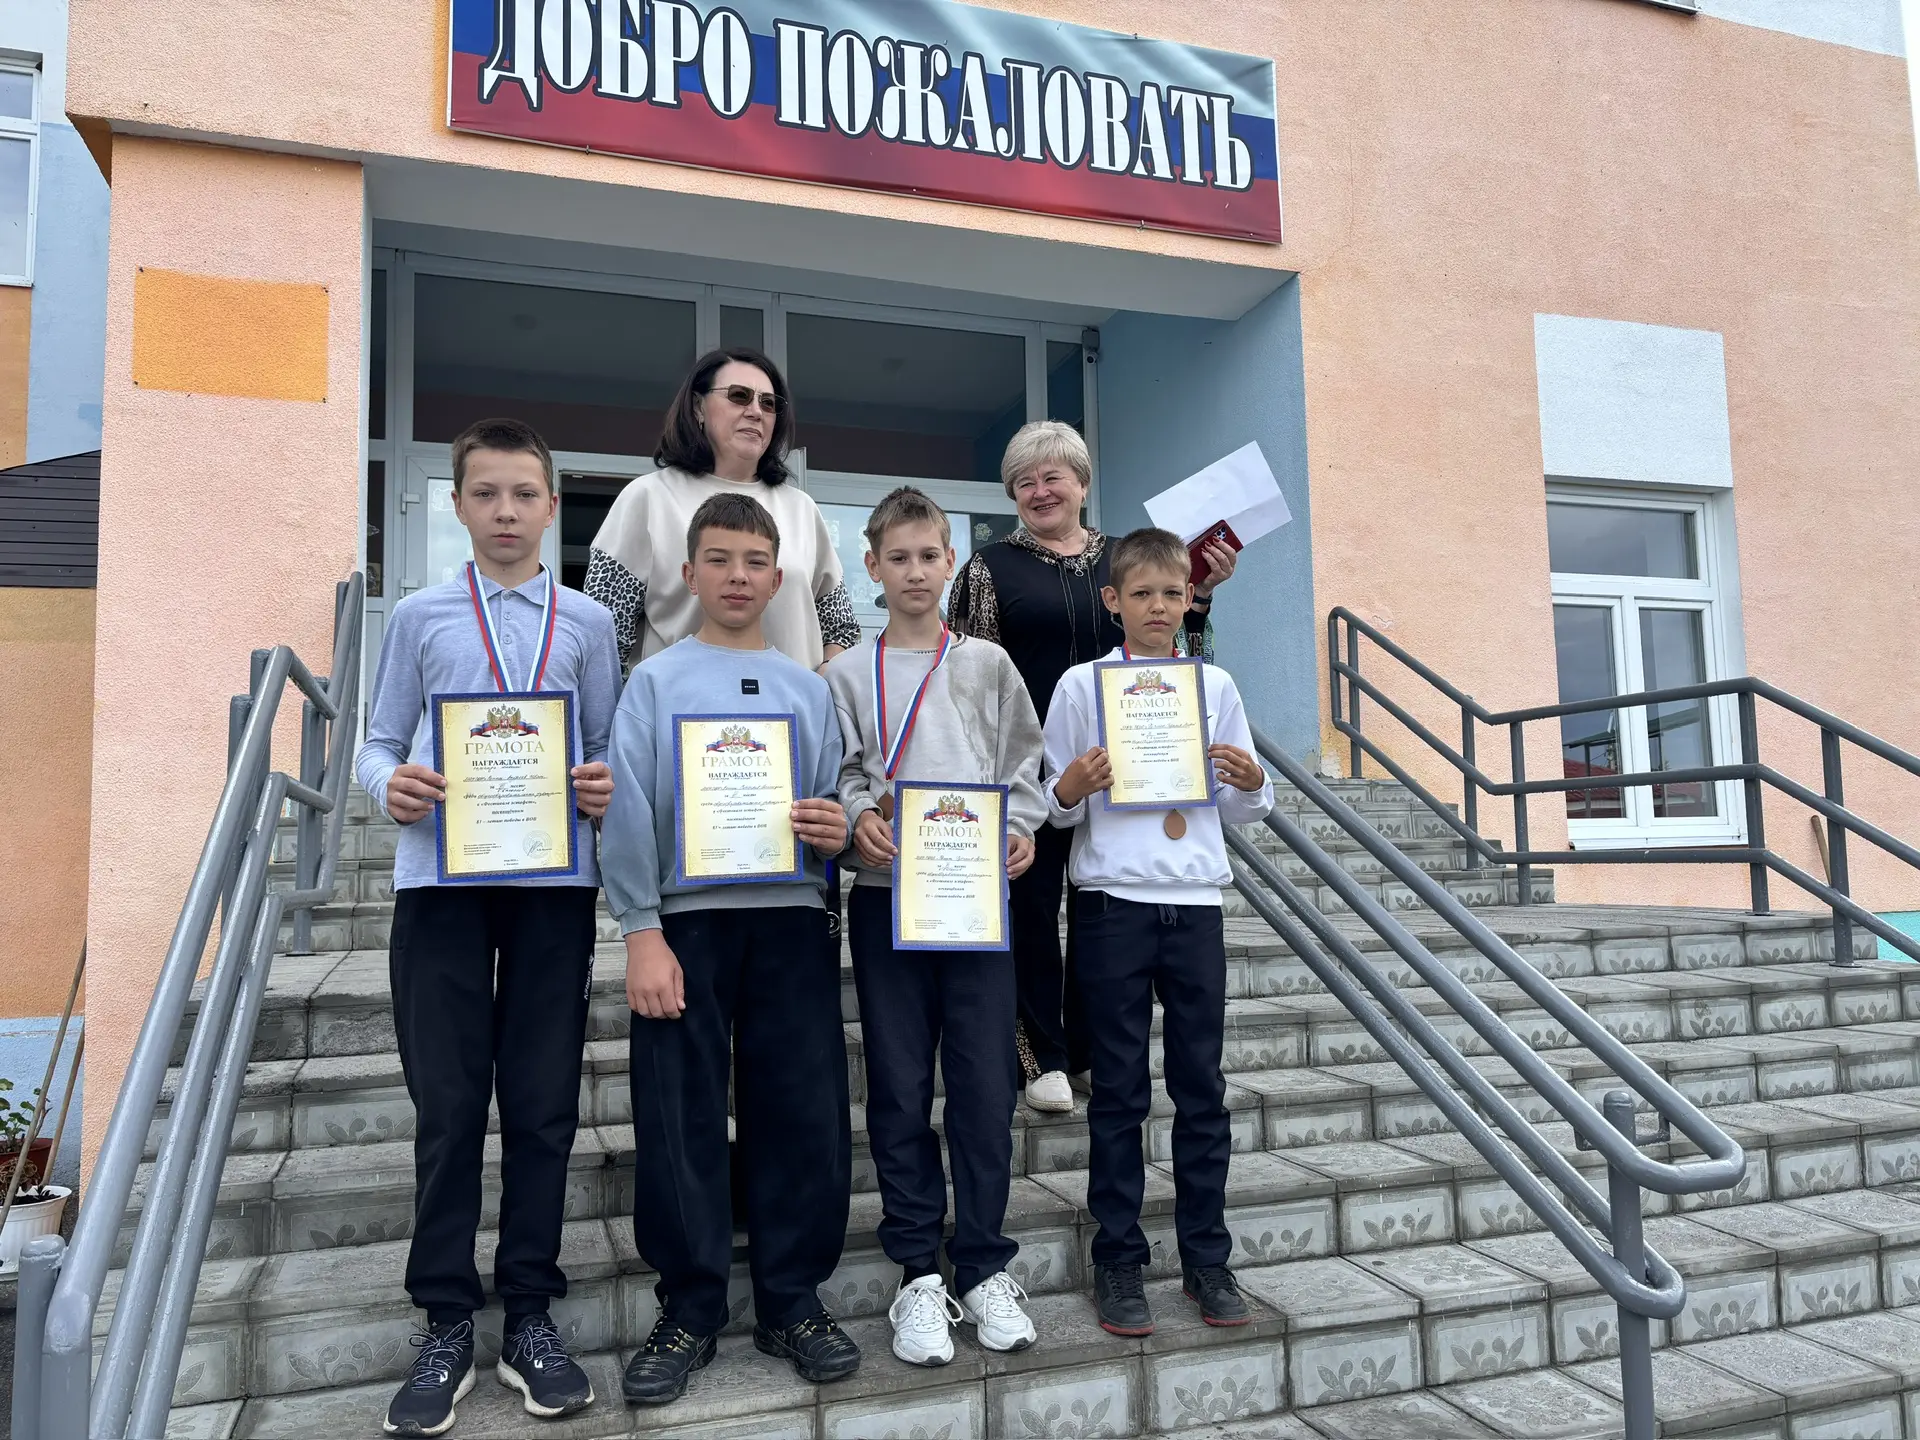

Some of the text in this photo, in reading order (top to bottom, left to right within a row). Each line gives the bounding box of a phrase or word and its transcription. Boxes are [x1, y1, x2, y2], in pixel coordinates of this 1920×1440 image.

[479, 0, 1253, 191] ДОБРО ПОЖАЛОВАТЬ
[1119, 697, 1182, 709] ГРАМОТА
[1126, 711, 1178, 719] НАГРАЖДАЕТСЯ
[464, 740, 546, 755] ГРАМОТА
[472, 758, 539, 767] НАГРАЖДАЕТСЯ
[701, 755, 772, 768] ГРАМОТА
[918, 825, 982, 838] ГРАМОТА
